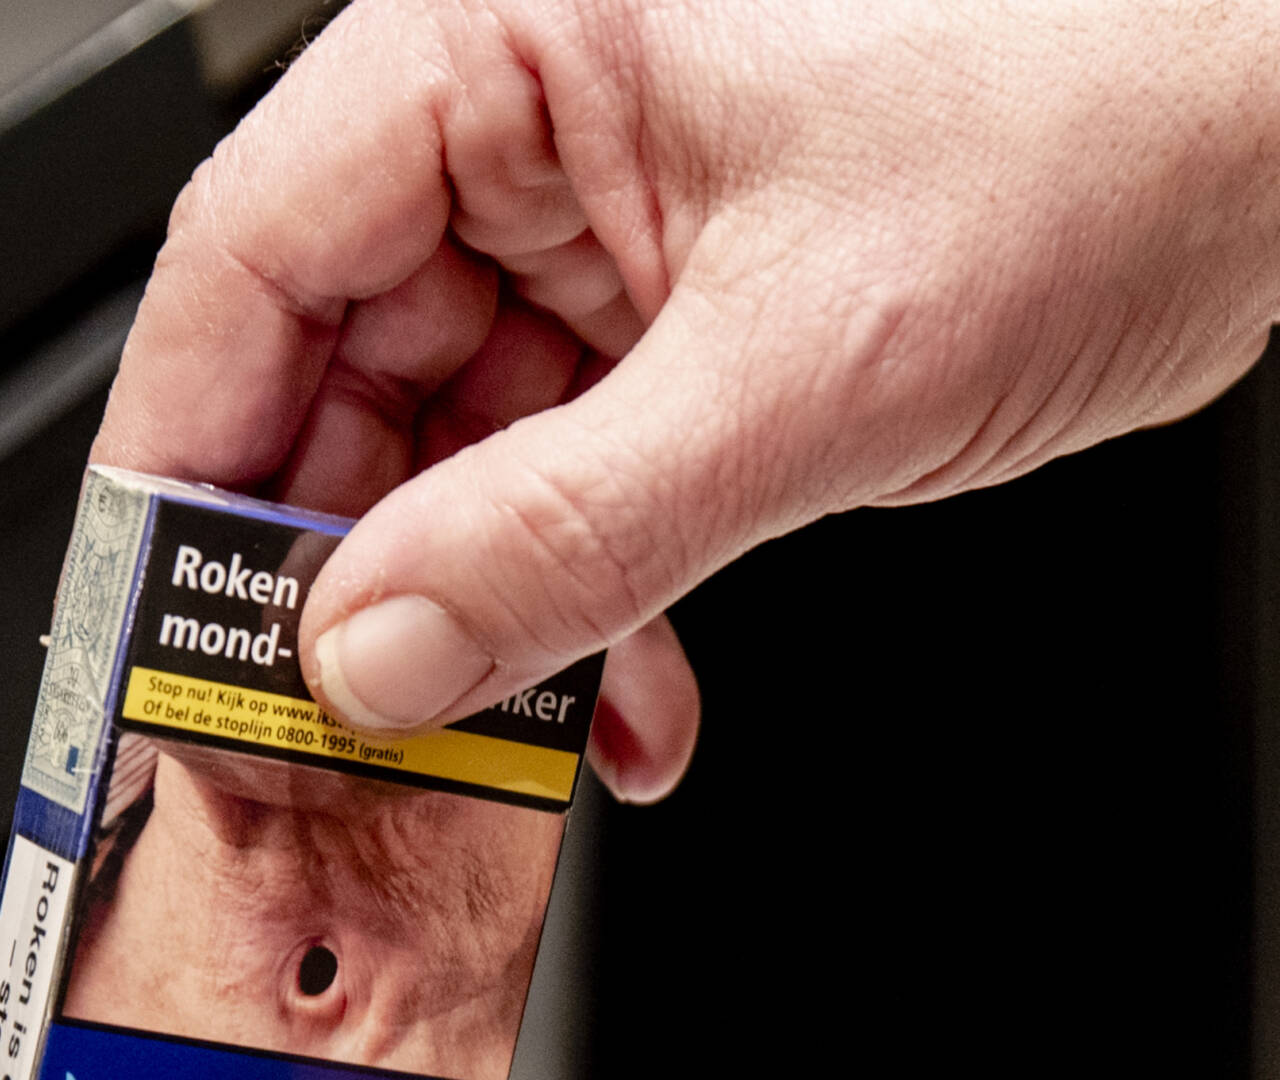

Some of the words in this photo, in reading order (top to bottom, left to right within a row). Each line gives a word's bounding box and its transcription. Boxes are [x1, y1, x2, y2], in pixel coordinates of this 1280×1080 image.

[171, 544, 300, 609] Roken
[159, 611, 293, 667] mond-
[147, 676, 183, 698] Stop
[186, 687, 213, 703] nu!
[216, 690, 245, 711] Kijk
[249, 699, 269, 715] op
[143, 699, 164, 715] Of
[165, 702, 190, 721] bel
[193, 709, 212, 726] de
[216, 716, 273, 741] stoplijn
[276, 725, 357, 755] 0800-1995
[359, 742, 405, 764] (gratis)
[19, 860, 60, 1006] Roken
[7, 1020, 28, 1057] is
